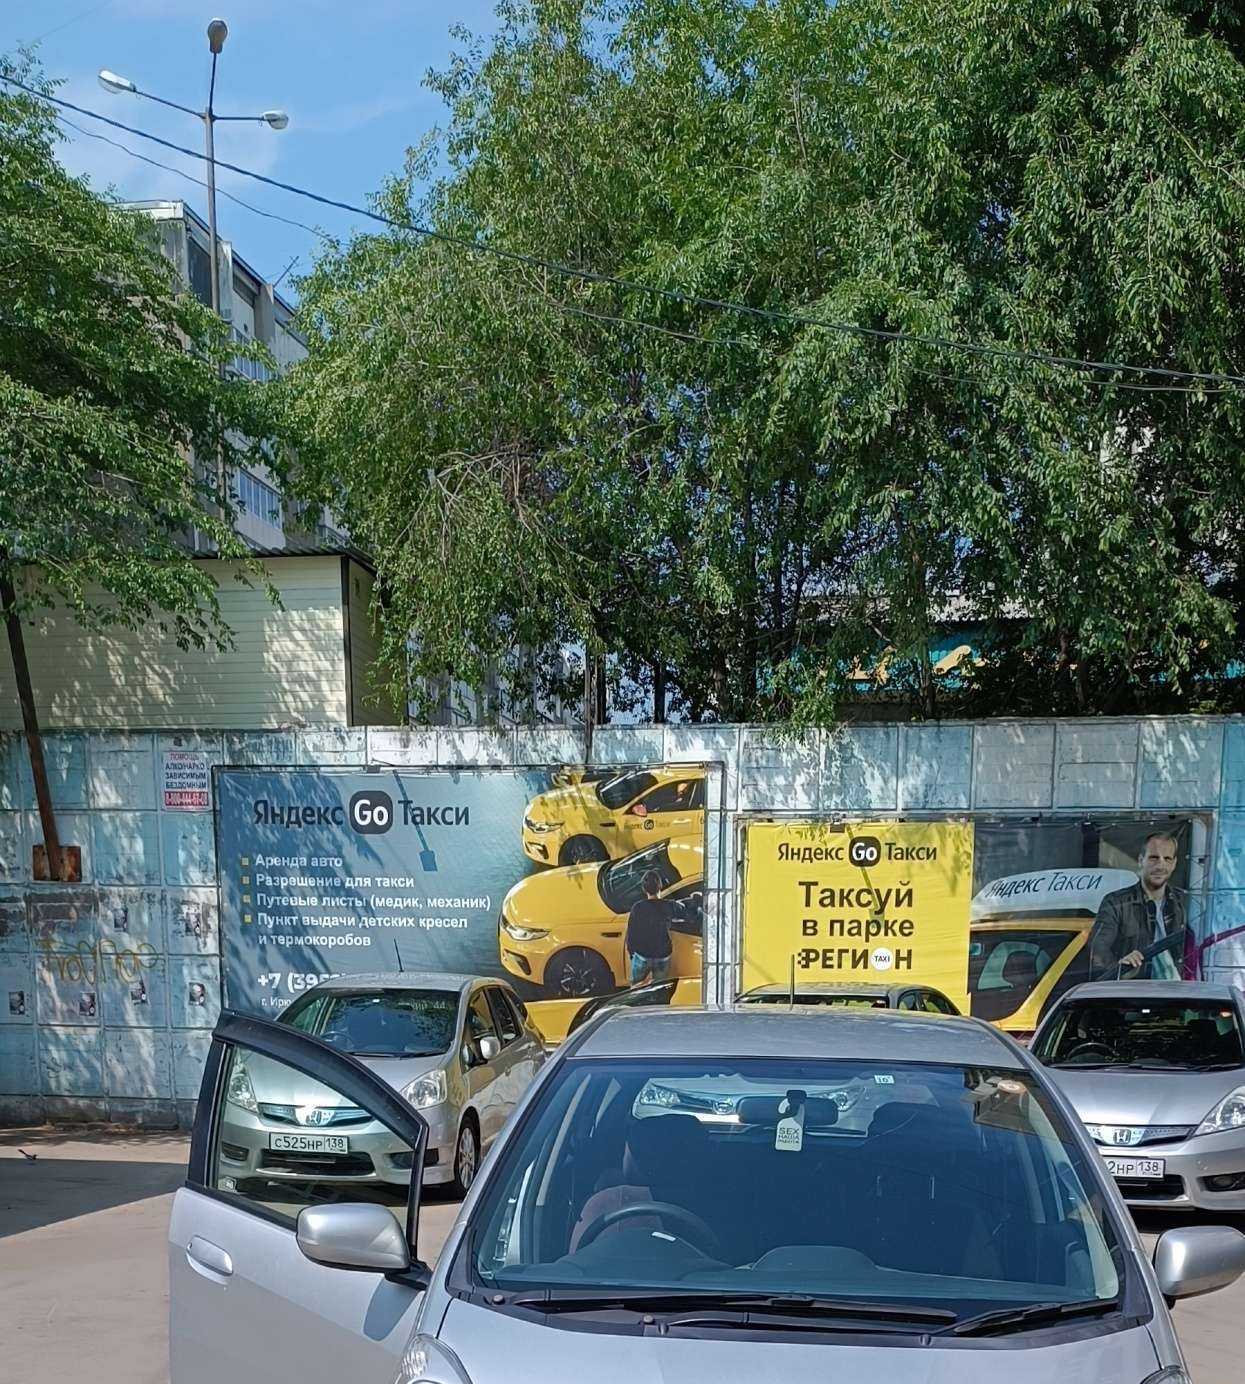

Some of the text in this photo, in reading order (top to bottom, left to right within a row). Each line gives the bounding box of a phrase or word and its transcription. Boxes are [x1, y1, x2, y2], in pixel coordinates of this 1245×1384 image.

[165, 772, 206, 780] ЗАВИСИМЫМ
[254, 799, 469, 829] Яндекс Go Такси
[778, 842, 937, 863] Яндекс Go Такси
[255, 854, 343, 868] Аренда авто
[256, 874, 415, 889] Разрешение для такси
[985, 872, 1103, 898] Яндекс Такси
[256, 894, 491, 911] Путевые листы (медик, механик)
[799, 881, 912, 915] Таксуй
[257, 912, 467, 929] Пункт выдачи детских кресел
[802, 919, 914, 943] в парке
[258, 934, 371, 949] и термокоробов
[257, 973, 281, 989] +7
[780, 1127, 799, 1136] SEX
[274, 1136, 344, 1150] С525НР 138
[1138, 1161, 1159, 1172] 138
